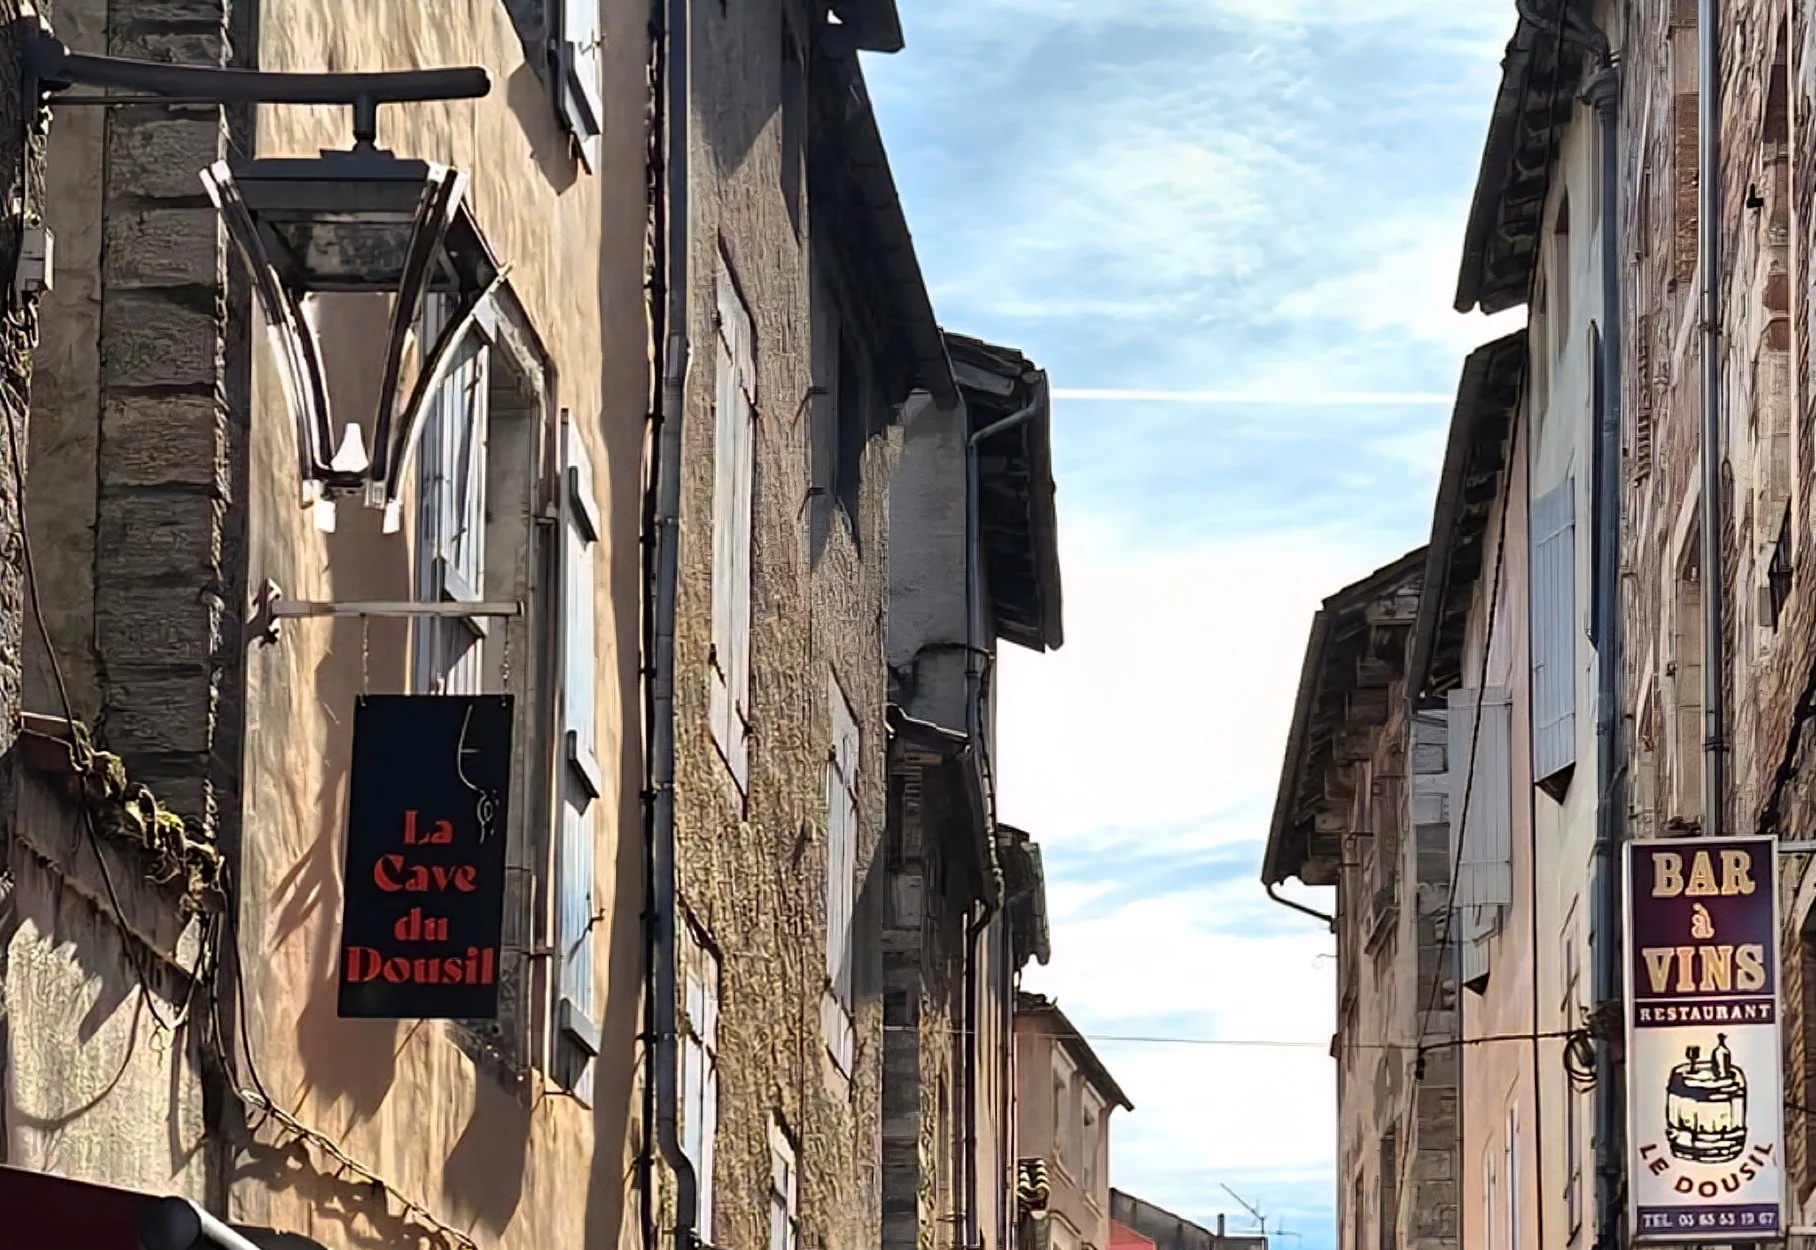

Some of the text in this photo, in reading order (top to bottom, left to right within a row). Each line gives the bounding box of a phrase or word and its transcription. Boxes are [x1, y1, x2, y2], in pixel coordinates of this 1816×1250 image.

[403, 810, 453, 845] La
[373, 853, 477, 892] Cave
[1652, 850, 1755, 898] BAR
[394, 907, 448, 941] du
[1691, 903, 1715, 939] à
[344, 946, 495, 984] Dousil
[1642, 945, 1766, 994] VINS
[1639, 1003, 1771, 1023] RESTAURANT
[1639, 1142, 1774, 1199] LE DOUSIL
